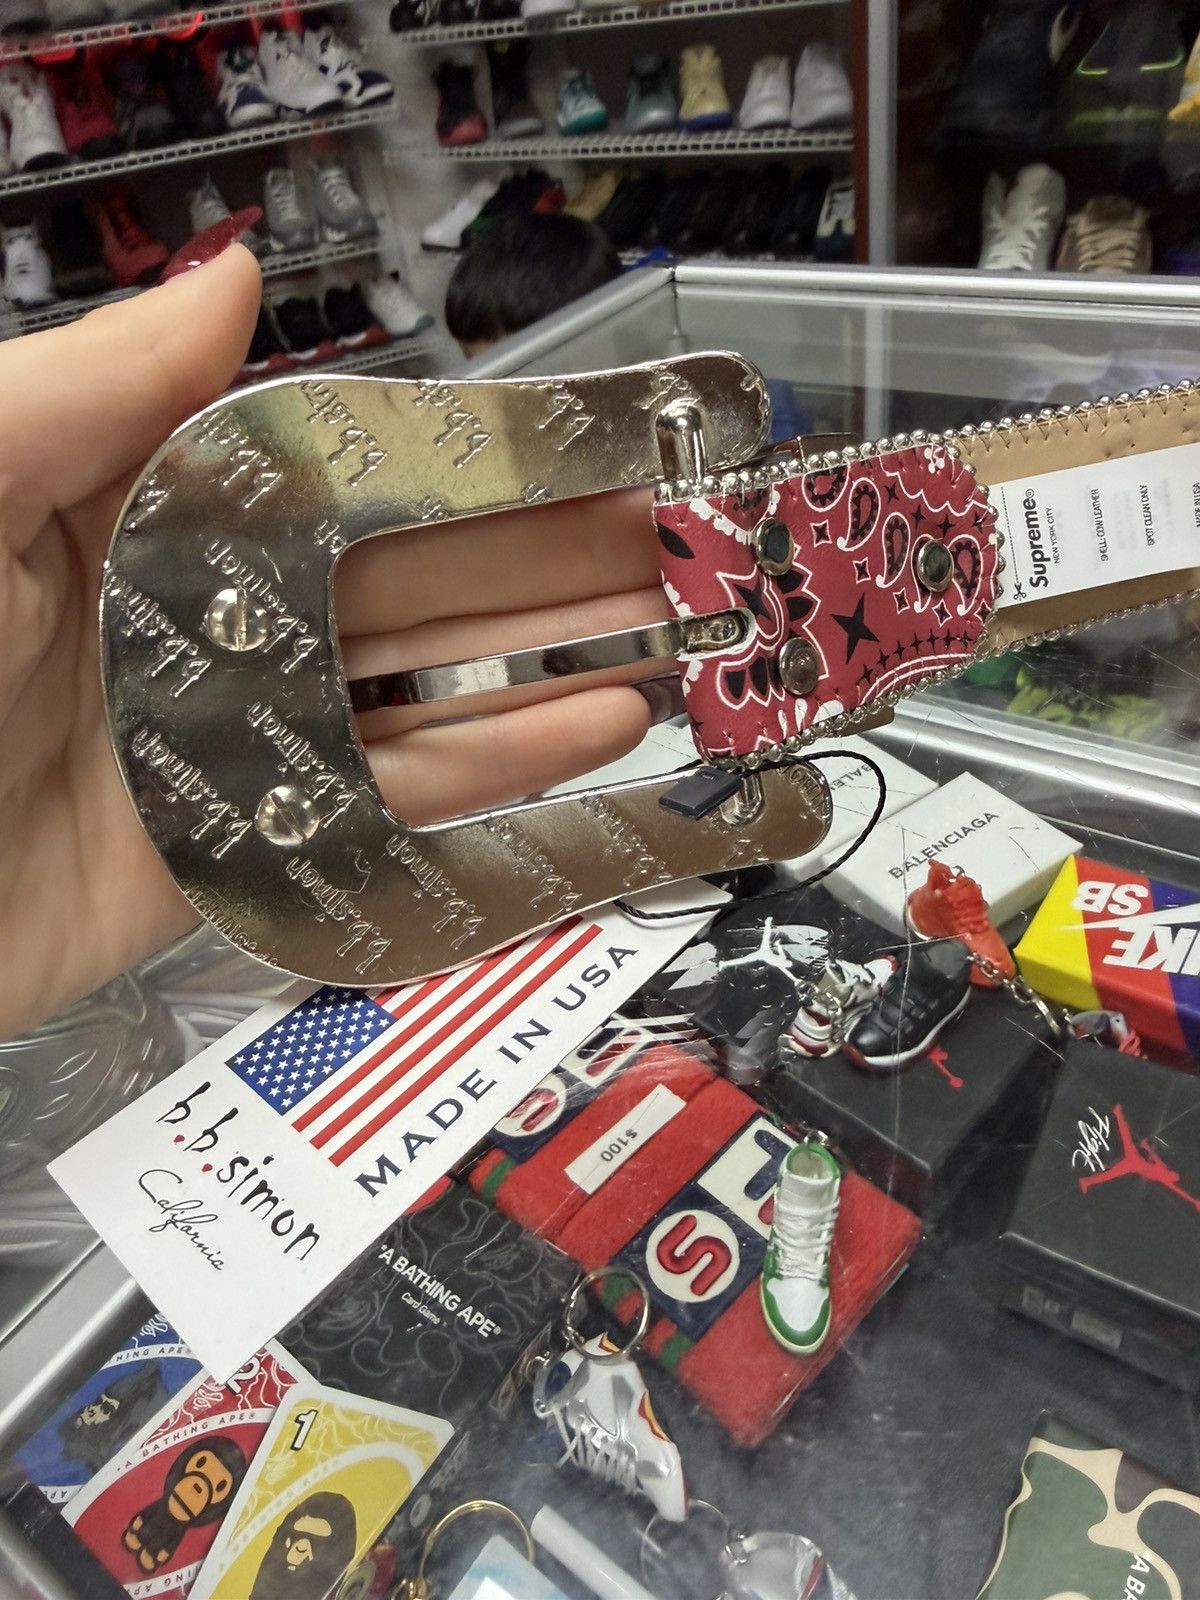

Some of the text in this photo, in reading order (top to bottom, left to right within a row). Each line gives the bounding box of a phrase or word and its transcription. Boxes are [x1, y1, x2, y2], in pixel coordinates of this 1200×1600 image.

[1046, 507, 1060, 564] NEW YORK CITY
[1139, 484, 1155, 547] SPOT CLEAN ONLY
[888, 811, 999, 879] BALENCIAGA
[1071, 880, 1149, 916] SB
[354, 1068, 498, 1198] MADE
[497, 1018, 552, 1064] IN
[552, 946, 639, 1012] USA
[600, 1128, 638, 1162] $100
[138, 1168, 225, 1271] California
[392, 1255, 461, 1312] BATHING
[142, 1422, 209, 1458] BATHING
[290, 1409, 319, 1451] 1
